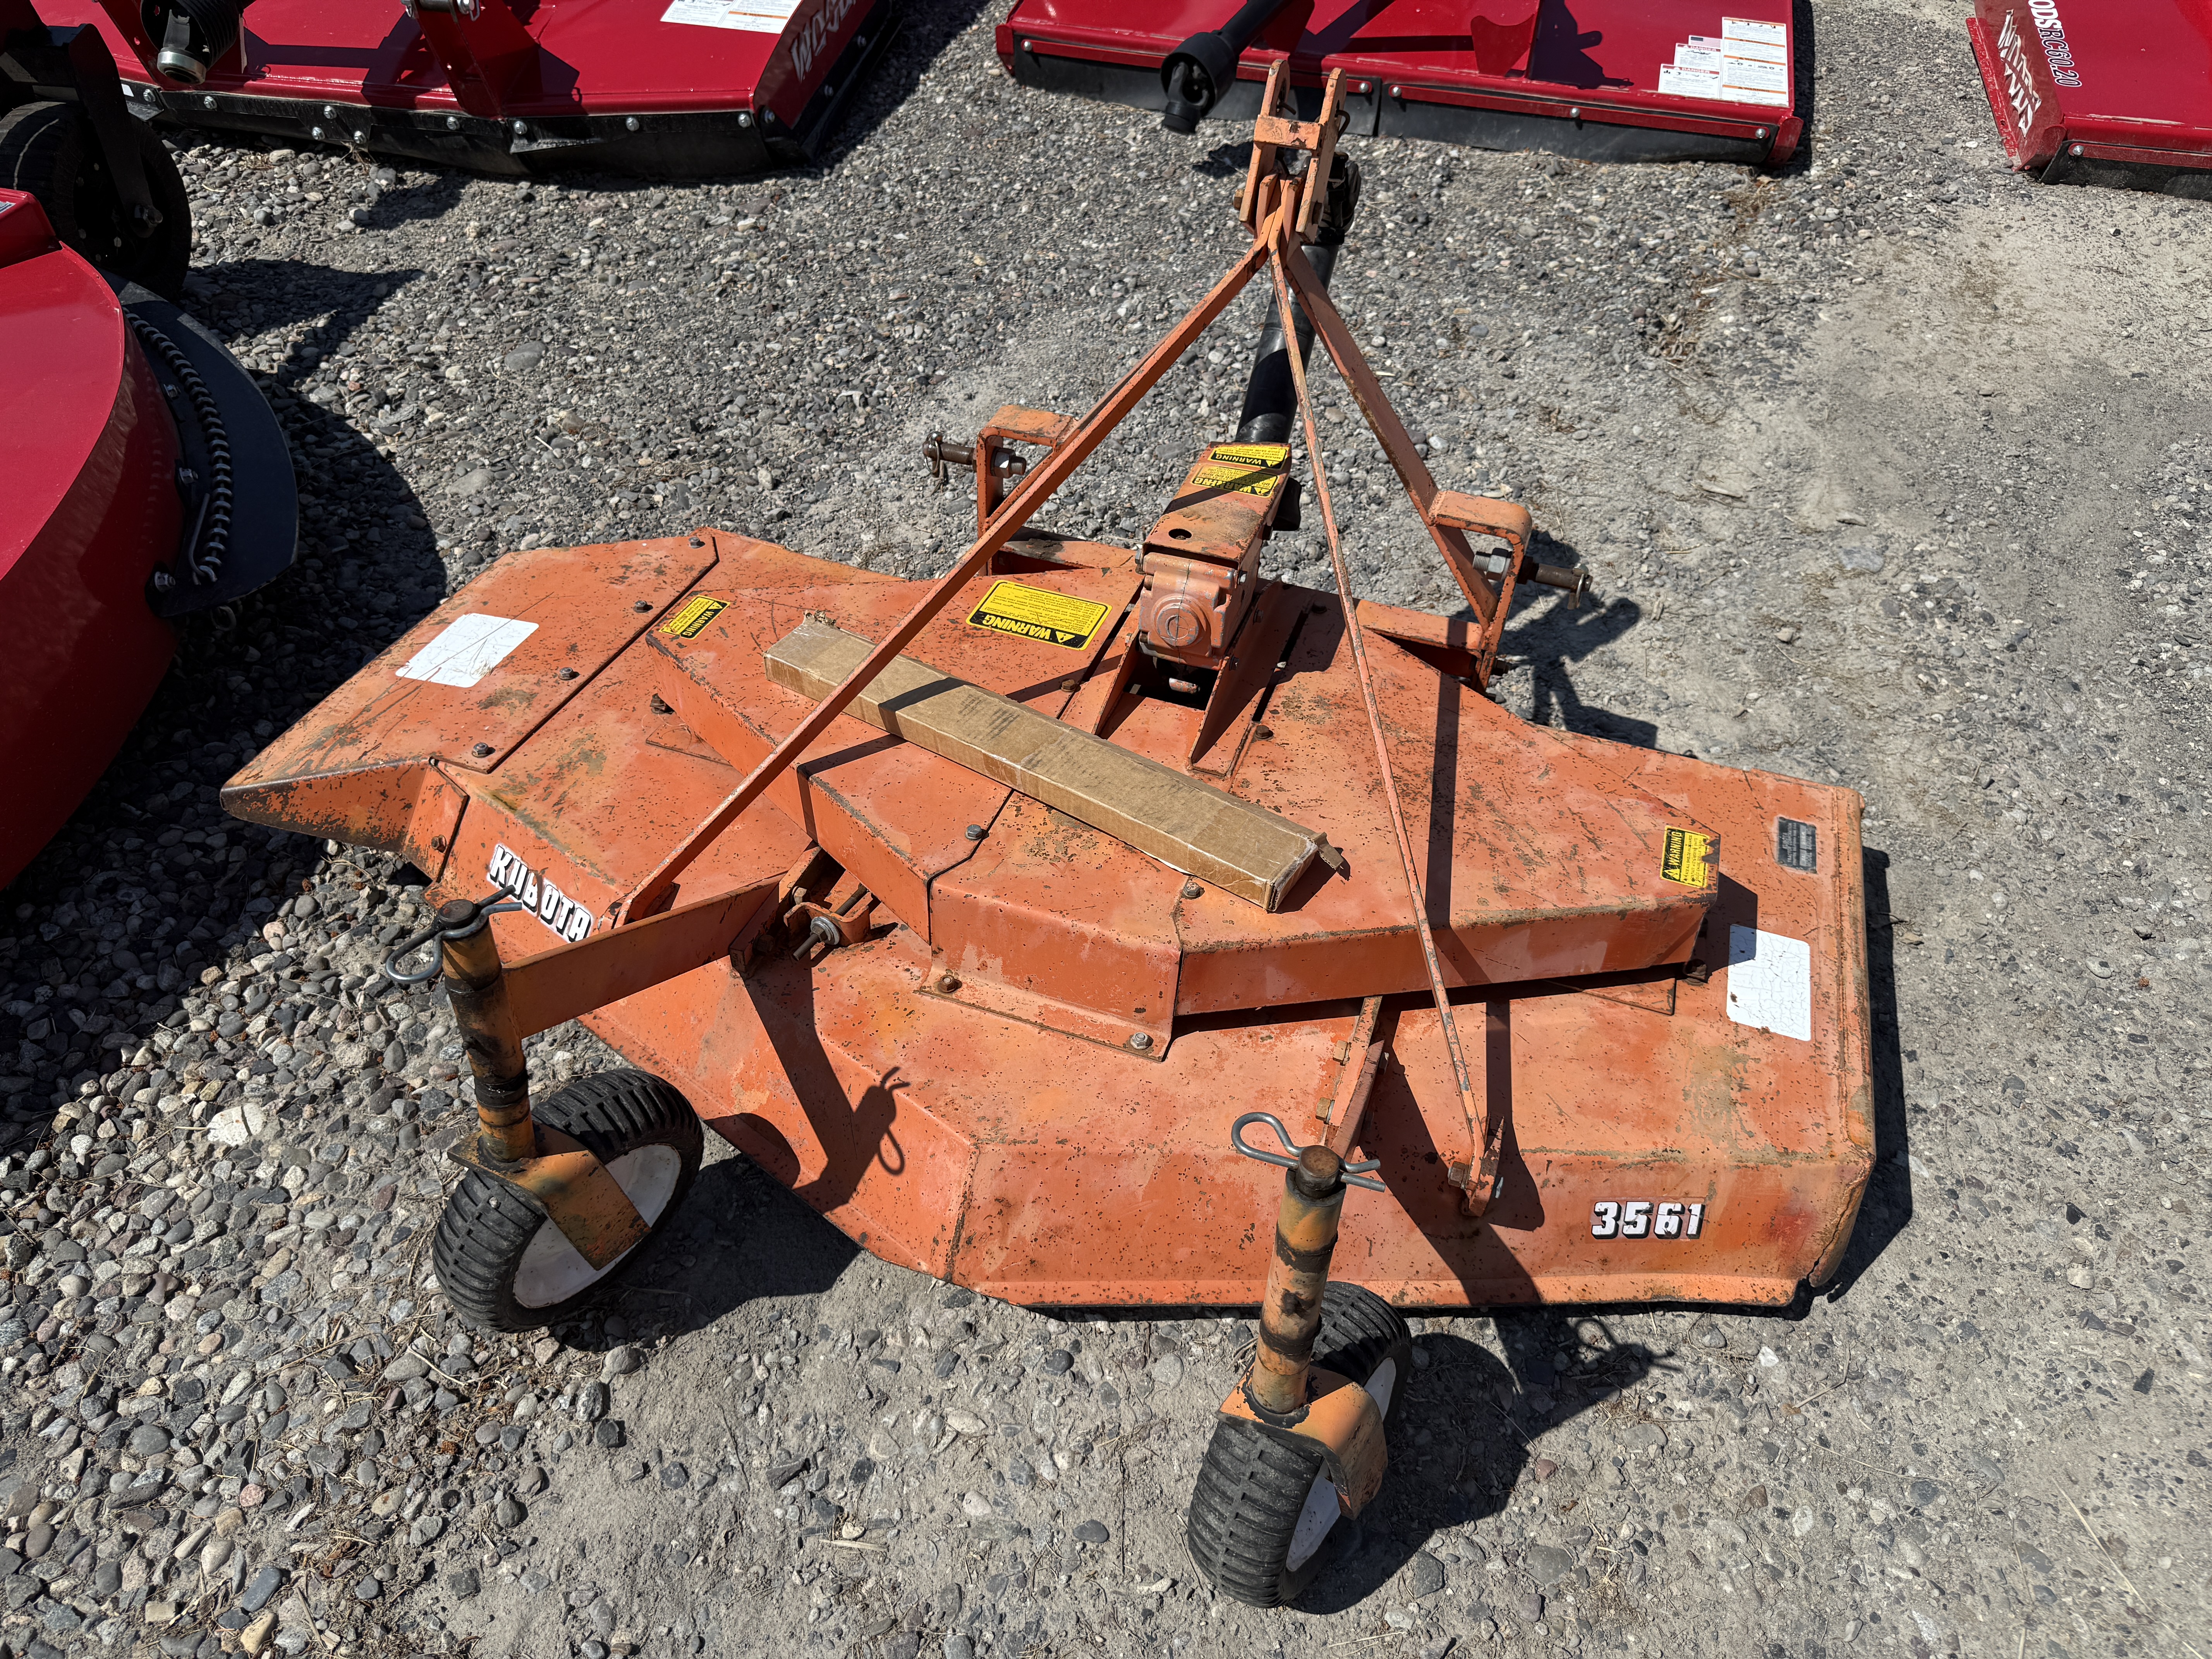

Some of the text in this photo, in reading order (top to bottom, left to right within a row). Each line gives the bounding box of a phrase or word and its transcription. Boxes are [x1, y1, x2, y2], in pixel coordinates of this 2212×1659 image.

[1215, 454, 1261, 464] WARNING
[682, 611, 714, 636] WARNING
[980, 614, 1052, 640] WARNING
[1668, 831, 1682, 865] WARNING
[489, 845, 591, 942] KUBOTA
[1591, 1201, 1706, 1240] 3561
